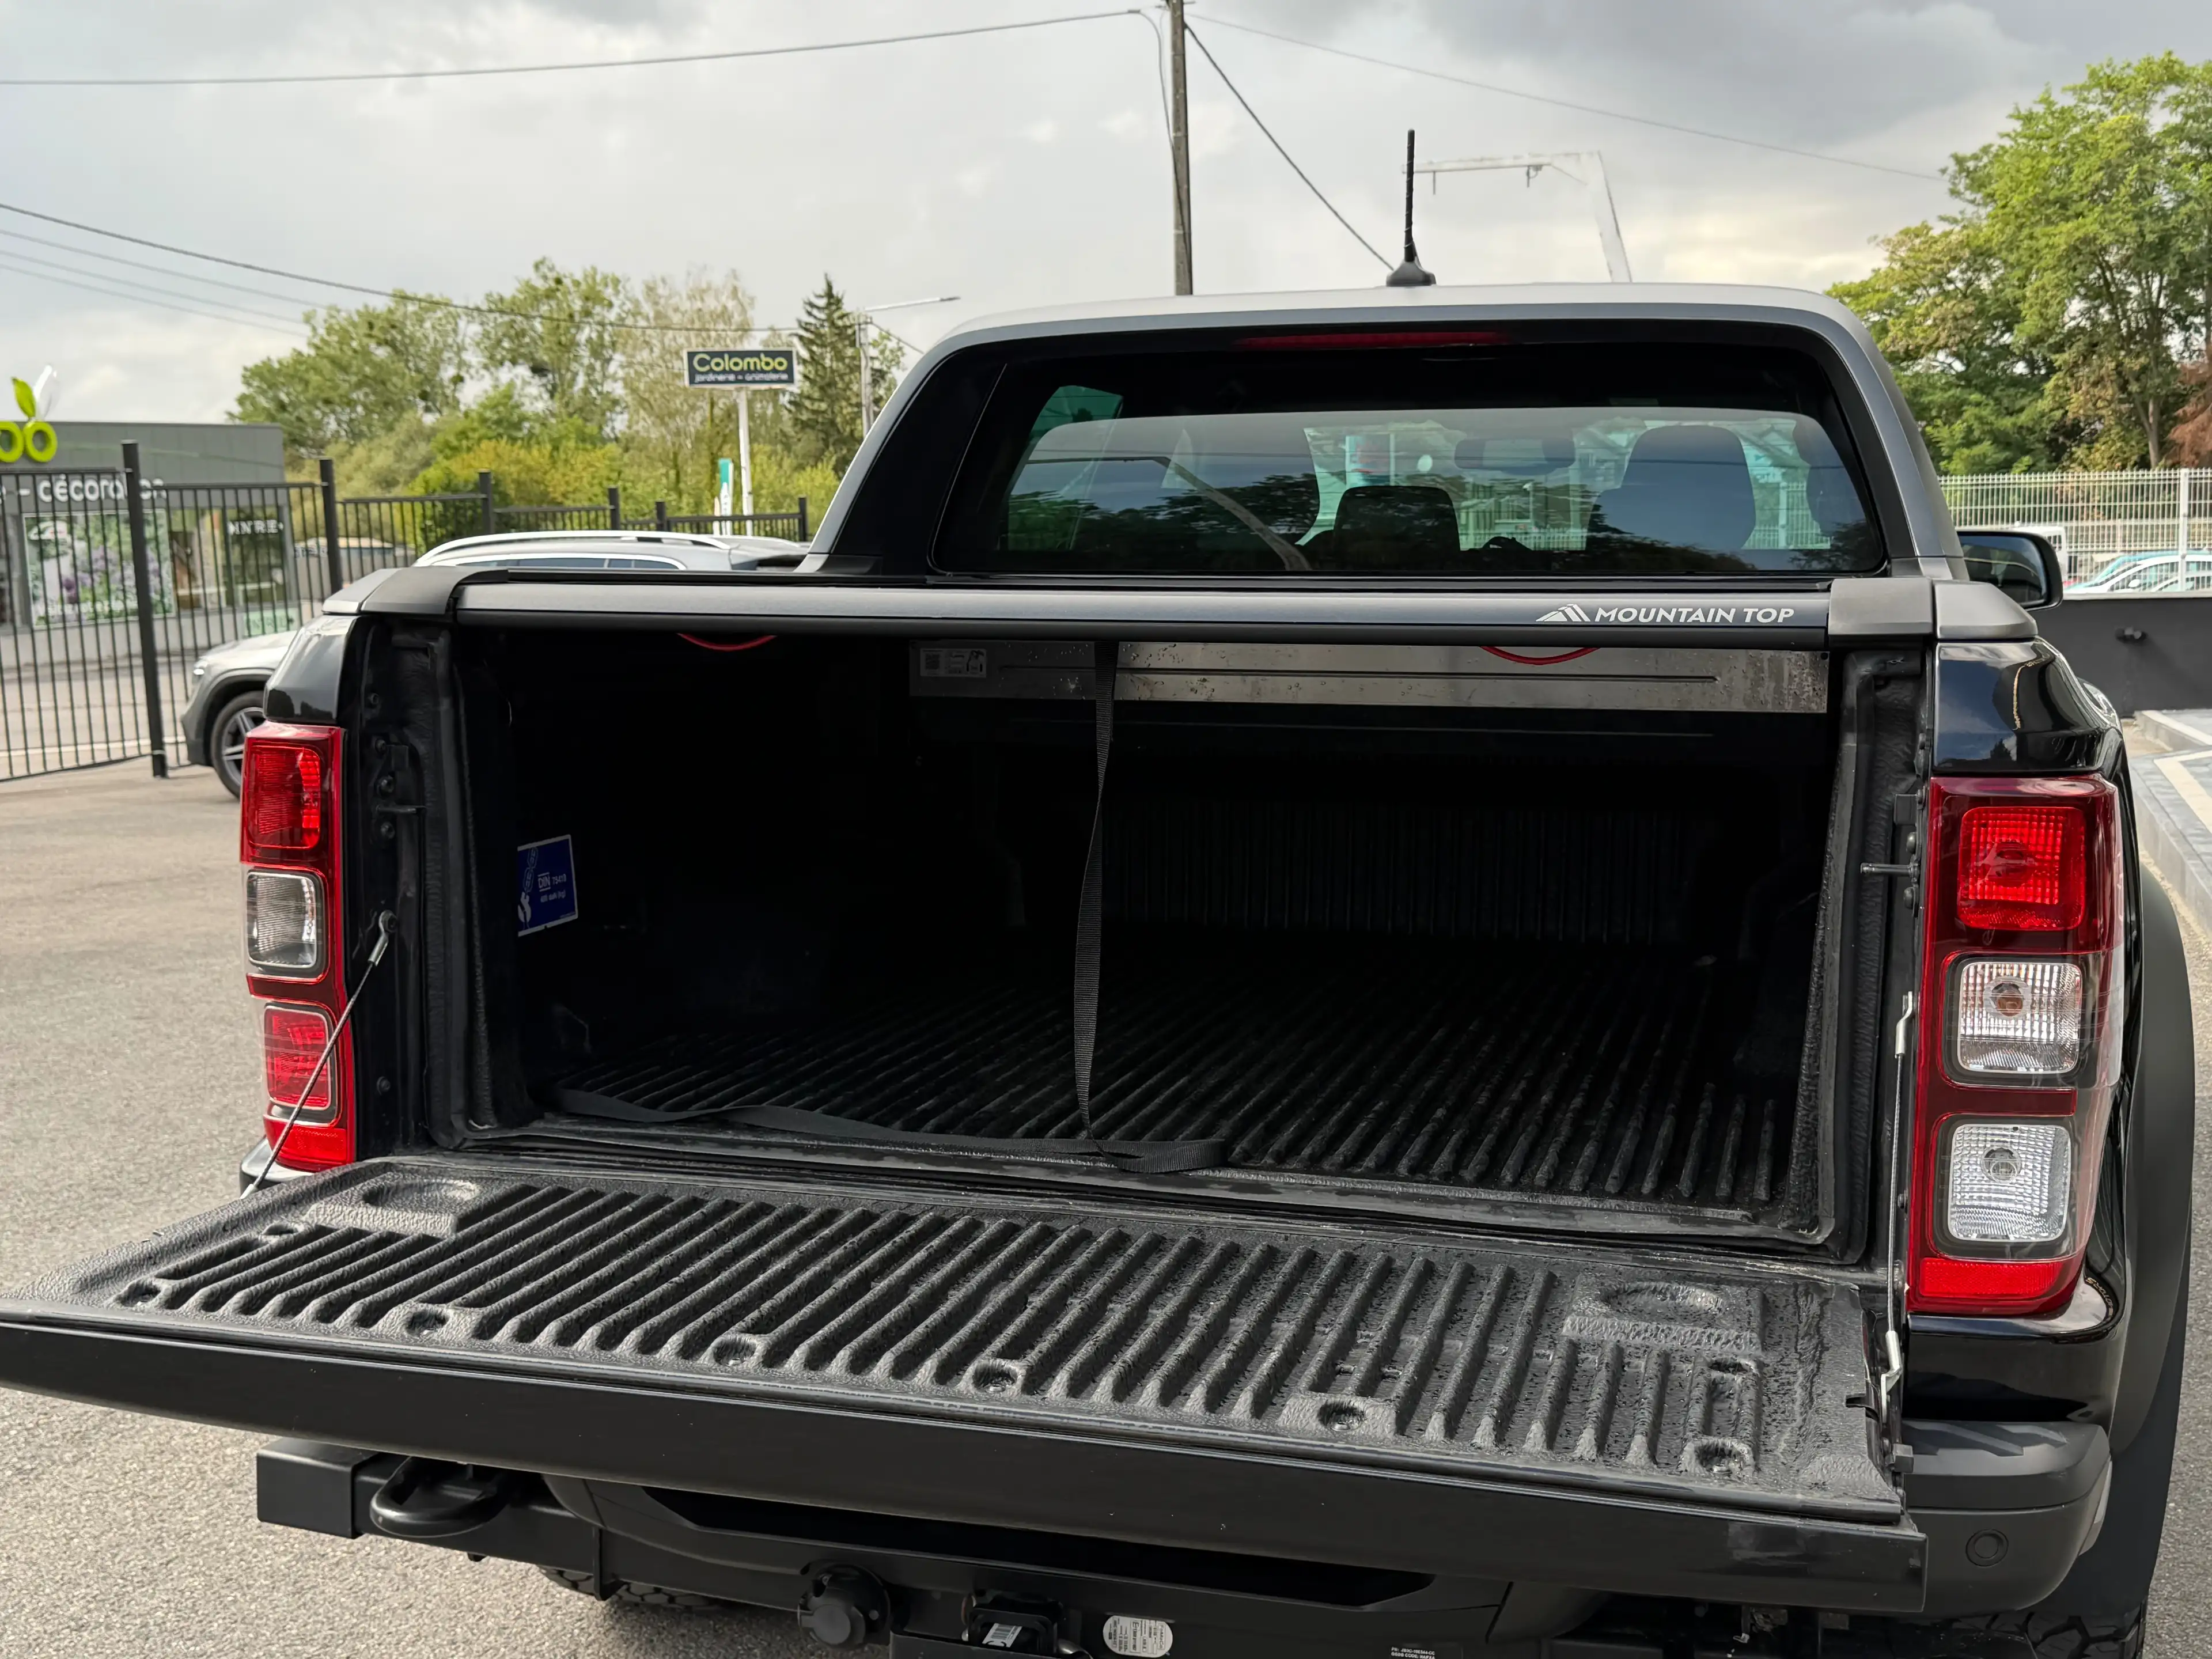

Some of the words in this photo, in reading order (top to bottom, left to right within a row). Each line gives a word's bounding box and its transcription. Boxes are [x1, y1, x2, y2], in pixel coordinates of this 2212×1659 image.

[693, 353, 788, 372] Colombo
[39, 474, 167, 502] décoraon
[1594, 607, 1736, 623] MOUNTAIN
[1743, 608, 1795, 623] TOP
[538, 874, 551, 889] DIN
